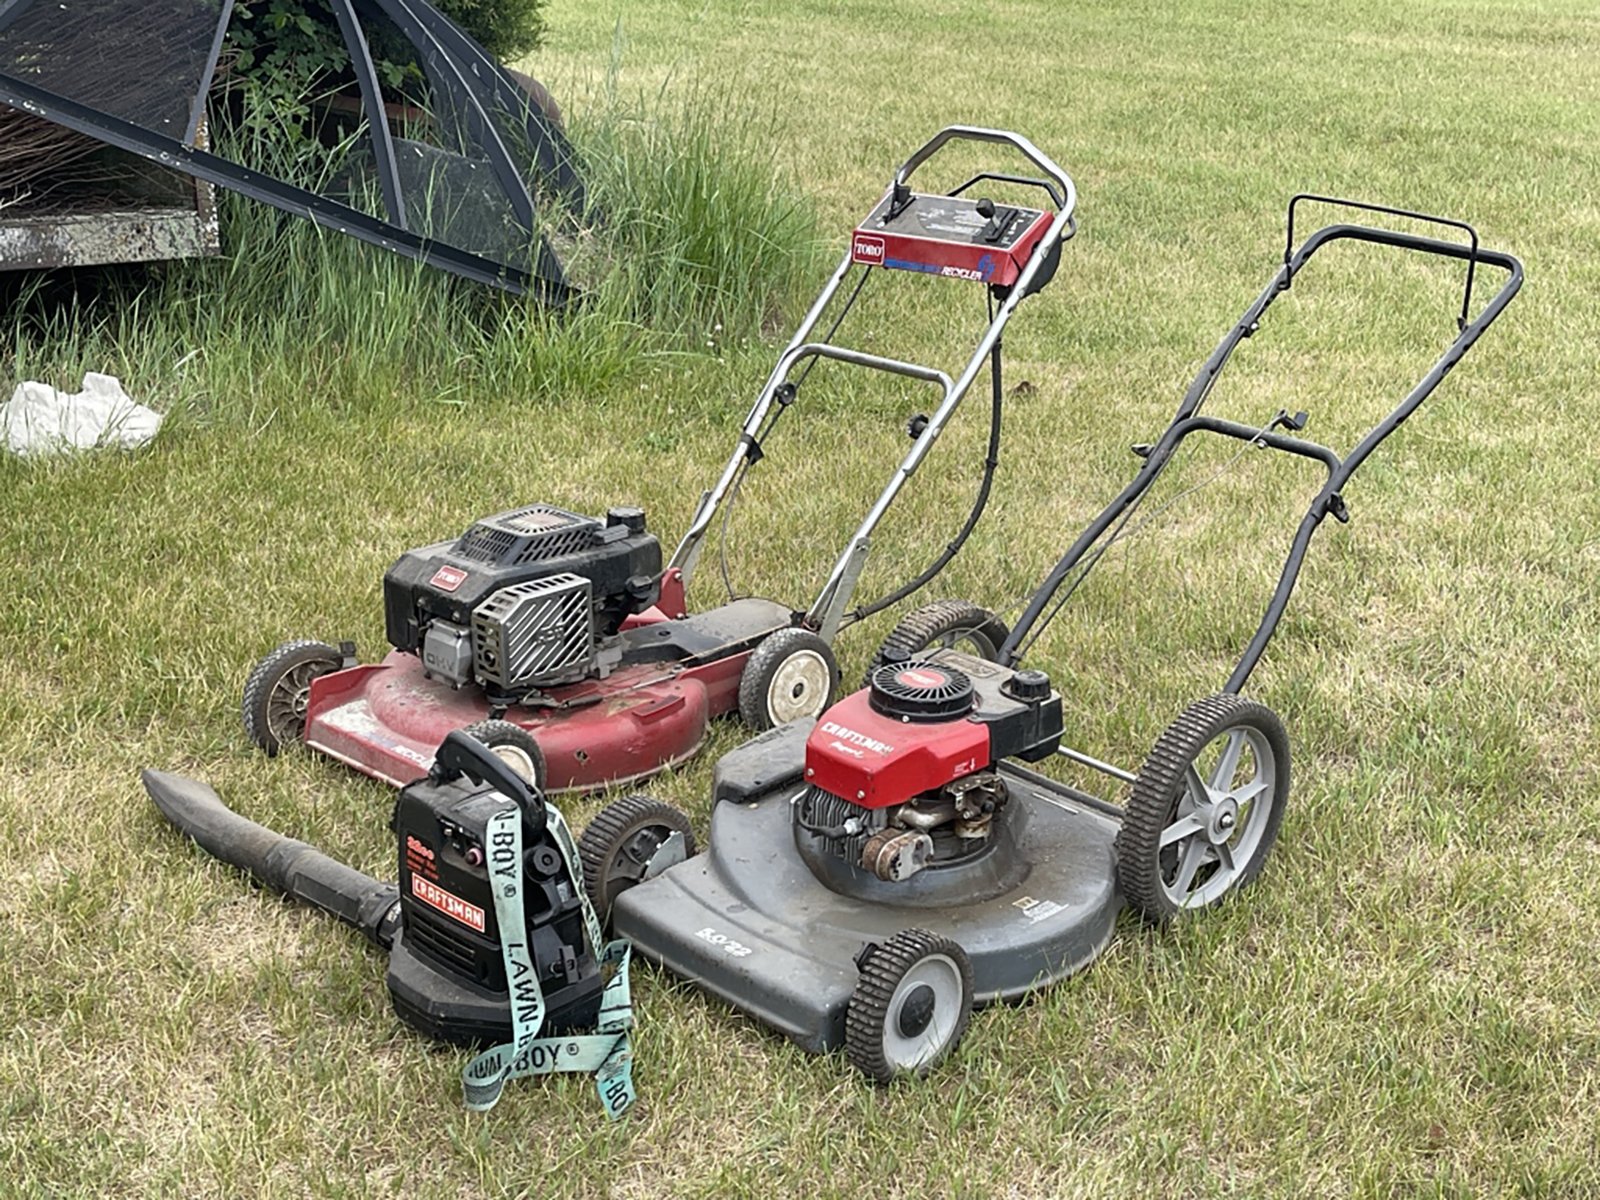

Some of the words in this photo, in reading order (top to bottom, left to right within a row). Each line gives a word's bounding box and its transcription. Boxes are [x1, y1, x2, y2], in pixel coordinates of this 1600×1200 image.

[856, 243, 882, 257] TORO
[941, 265, 982, 280] RECYCLER
[414, 878, 482, 927] CRAFTSMAN
